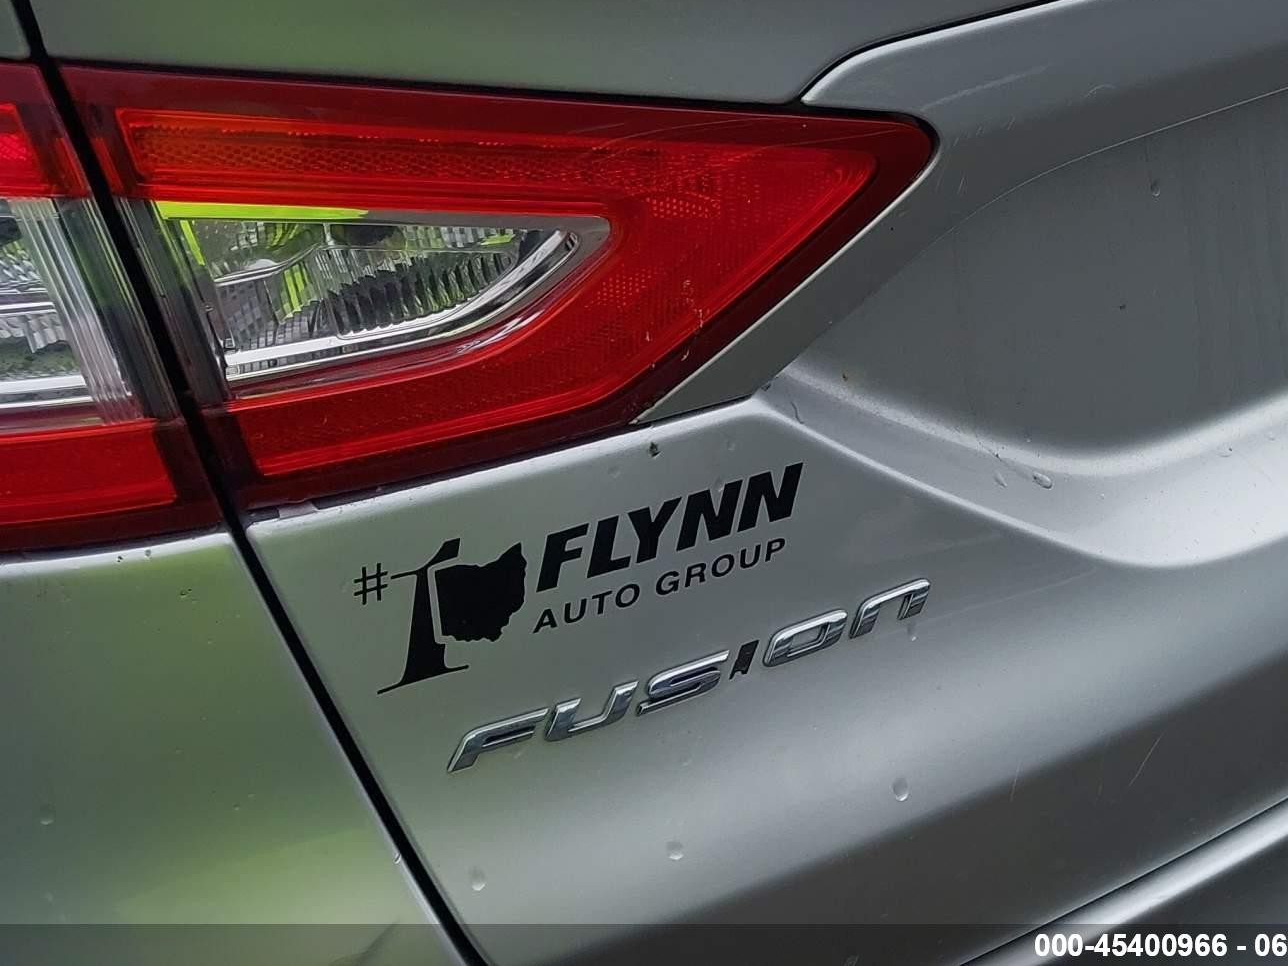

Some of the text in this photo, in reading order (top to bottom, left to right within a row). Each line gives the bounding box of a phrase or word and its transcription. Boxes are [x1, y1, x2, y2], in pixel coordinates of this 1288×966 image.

[532, 537, 788, 634] AUTO GROUP
[535, 462, 804, 594] FLYNN
[446, 577, 933, 774] FUSION
